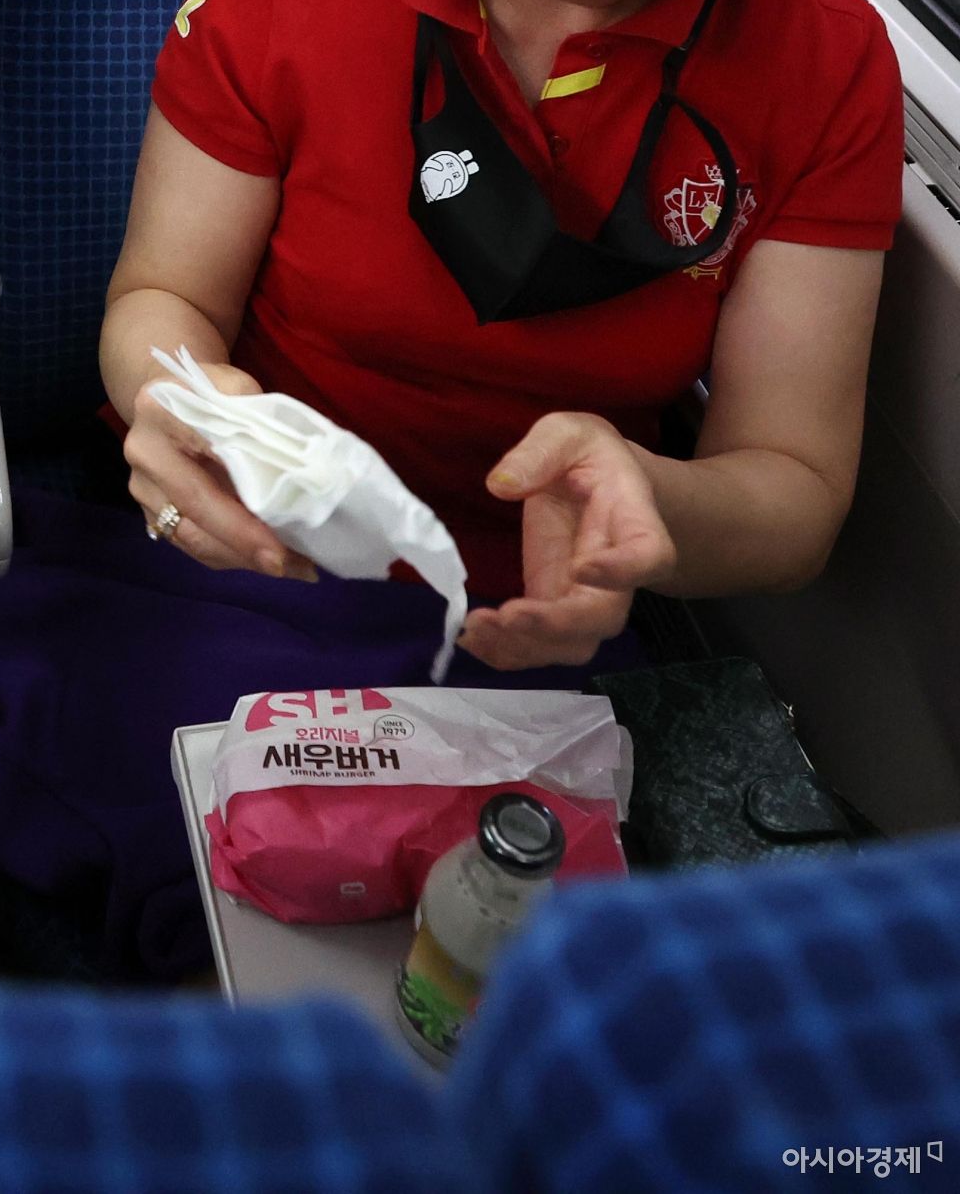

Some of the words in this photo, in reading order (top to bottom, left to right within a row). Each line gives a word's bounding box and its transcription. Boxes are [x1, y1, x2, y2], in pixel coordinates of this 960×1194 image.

[296, 727, 360, 744] 오리지널
[381, 726, 407, 736] 1979
[262, 743, 401, 771] 새우버거
[290, 768, 332, 778] SHRIMP
[334, 770, 376, 778] BURGER
